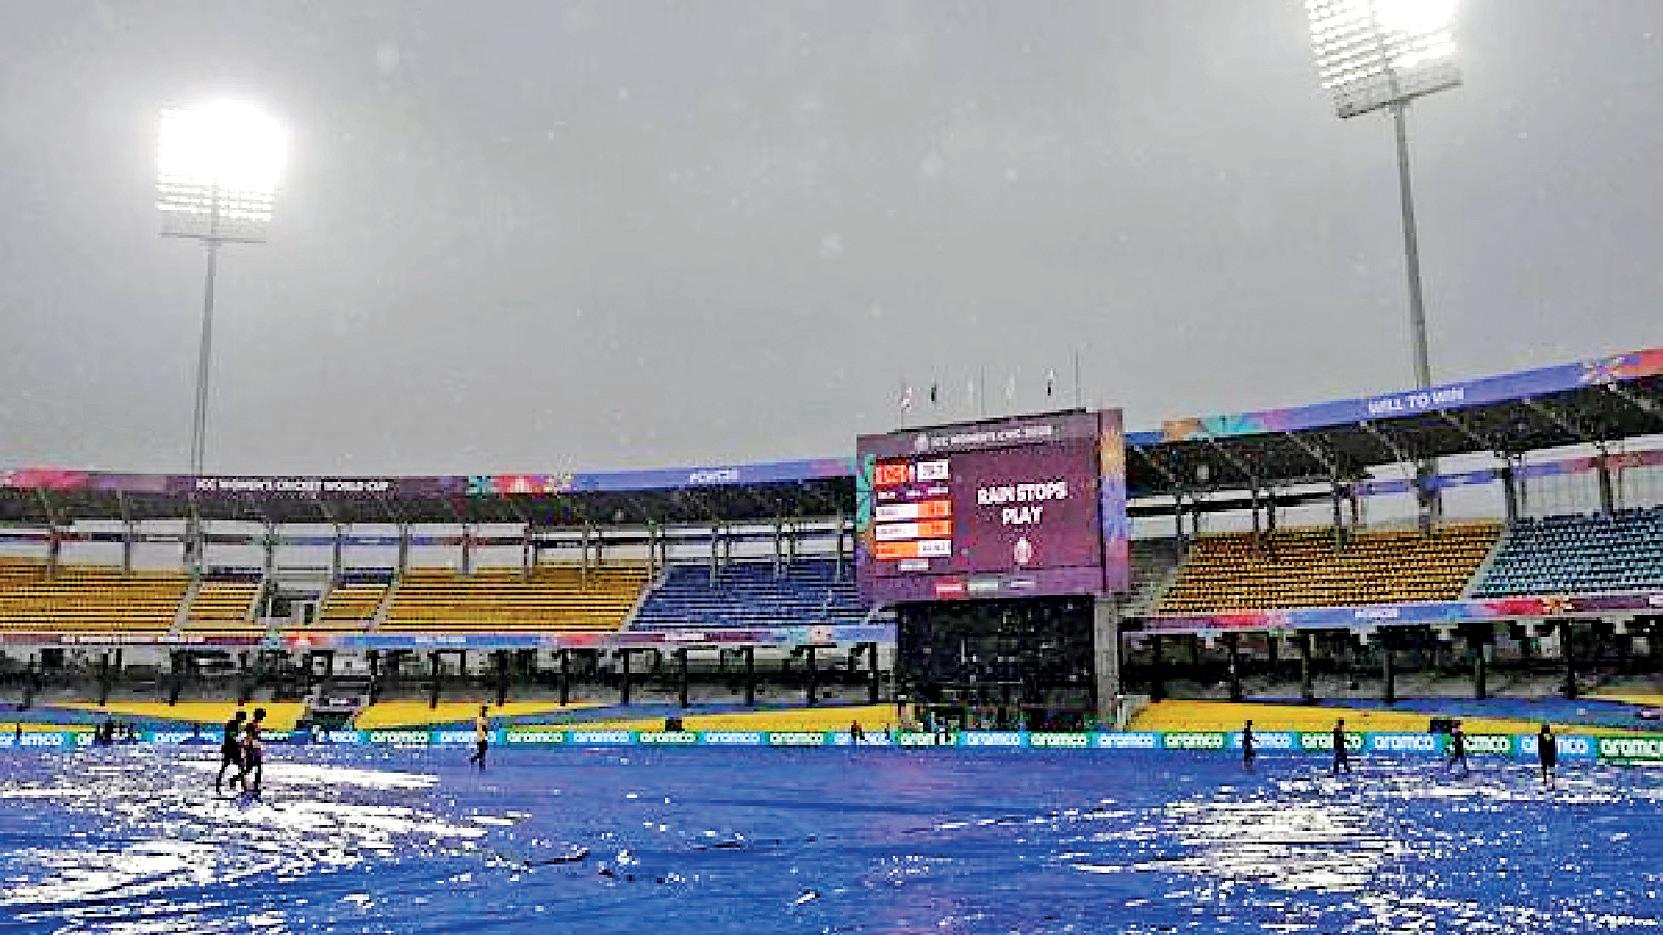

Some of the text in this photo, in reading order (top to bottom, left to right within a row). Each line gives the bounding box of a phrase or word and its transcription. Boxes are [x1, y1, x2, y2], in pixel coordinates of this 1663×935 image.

[1368, 387, 1464, 414] WILL TO WIN
[323, 480, 363, 492] WORLD
[977, 481, 1068, 504] RAIN STOPS
[1002, 506, 1043, 525] PLAY
[370, 731, 428, 743] aramco
[440, 731, 496, 743] aramo
[507, 731, 563, 743] aramco
[574, 731, 630, 743] aramco
[639, 731, 696, 743] aramco
[706, 731, 761, 743] aramco
[769, 731, 824, 743] aramco
[967, 733, 1020, 745] aramco
[1031, 733, 1087, 746] aramco
[1100, 733, 1155, 746] aramco
[1165, 734, 1223, 746] aramco
[1374, 735, 1434, 750] aramco
